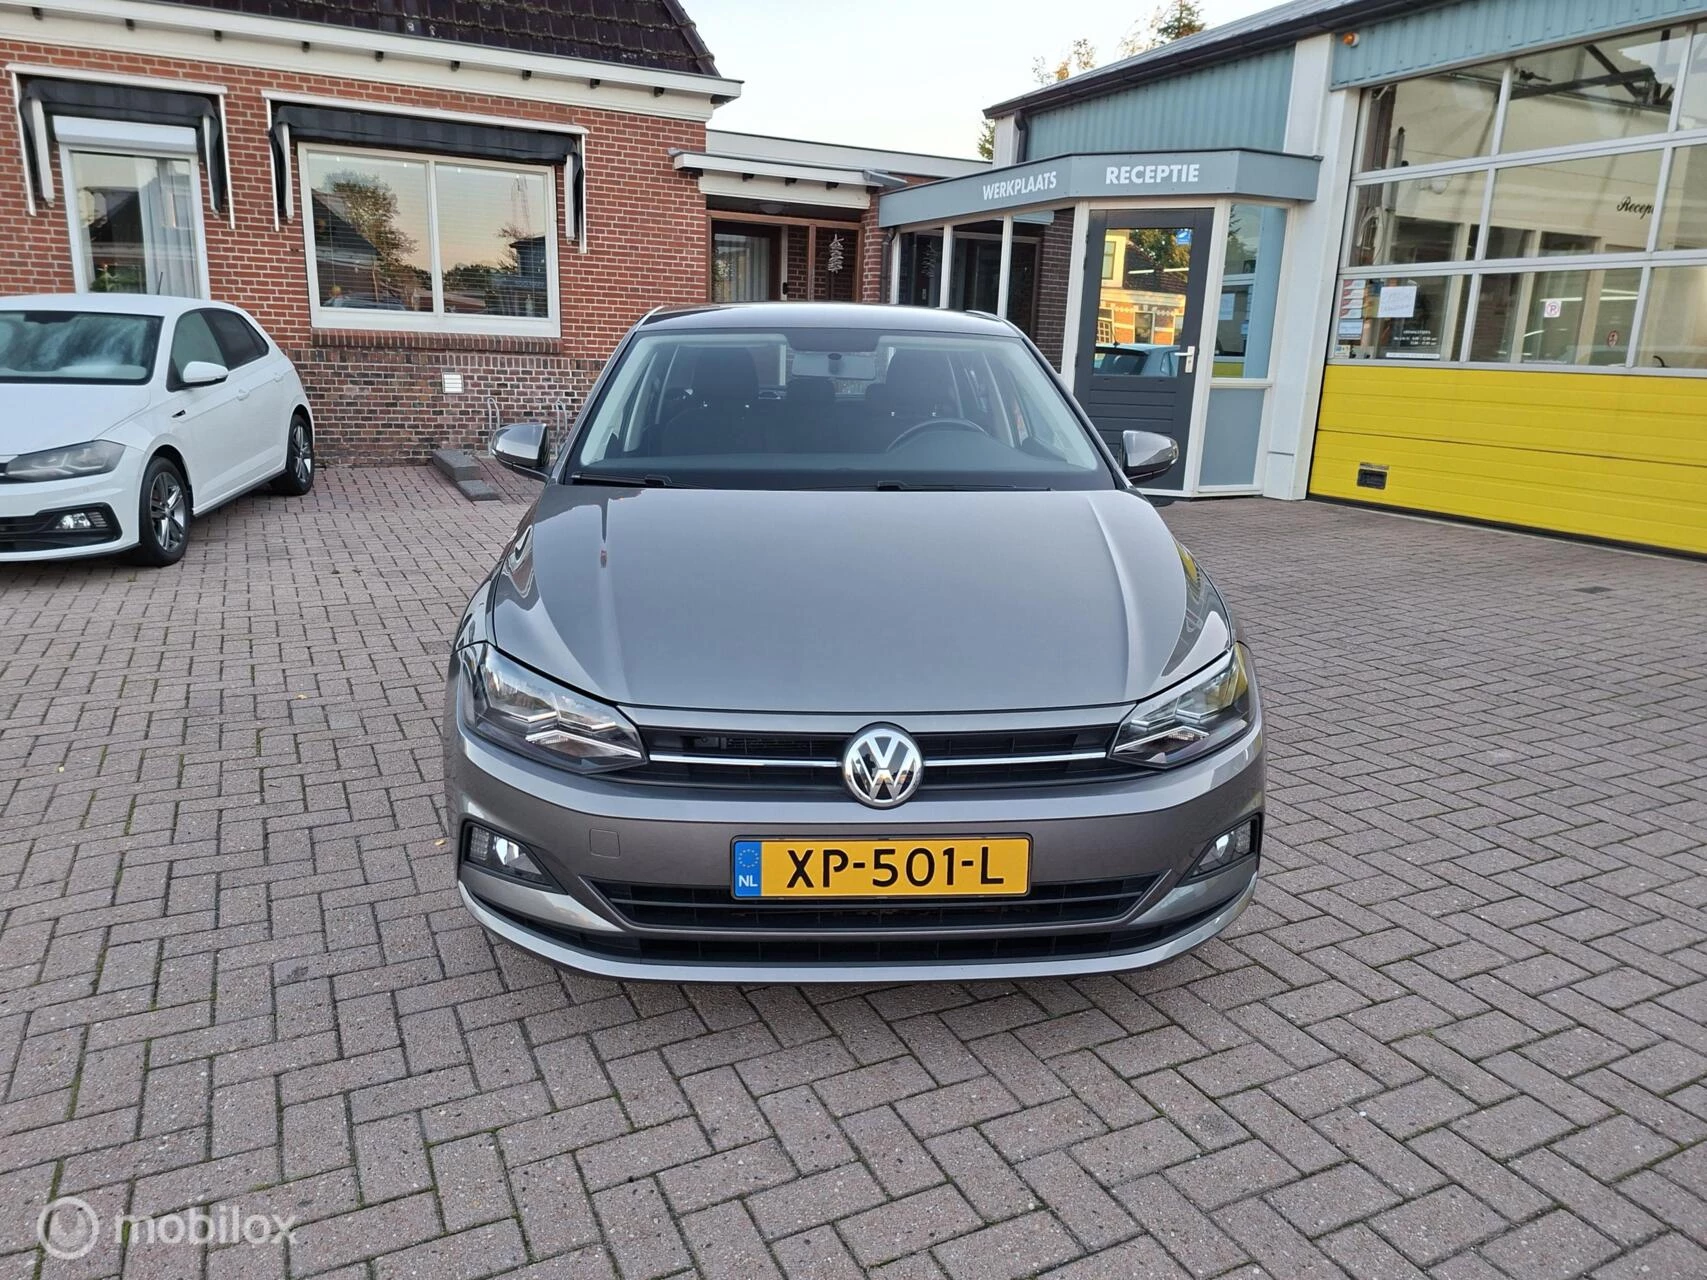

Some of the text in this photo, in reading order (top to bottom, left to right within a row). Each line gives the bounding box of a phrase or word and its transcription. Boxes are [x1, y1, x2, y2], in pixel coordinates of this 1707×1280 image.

[982, 170, 1057, 201] WERKPLAATS
[1105, 163, 1200, 185] RECEPTIE
[849, 733, 920, 802] VW
[738, 874, 758, 888] NL
[786, 846, 1004, 889] XP-501-L
